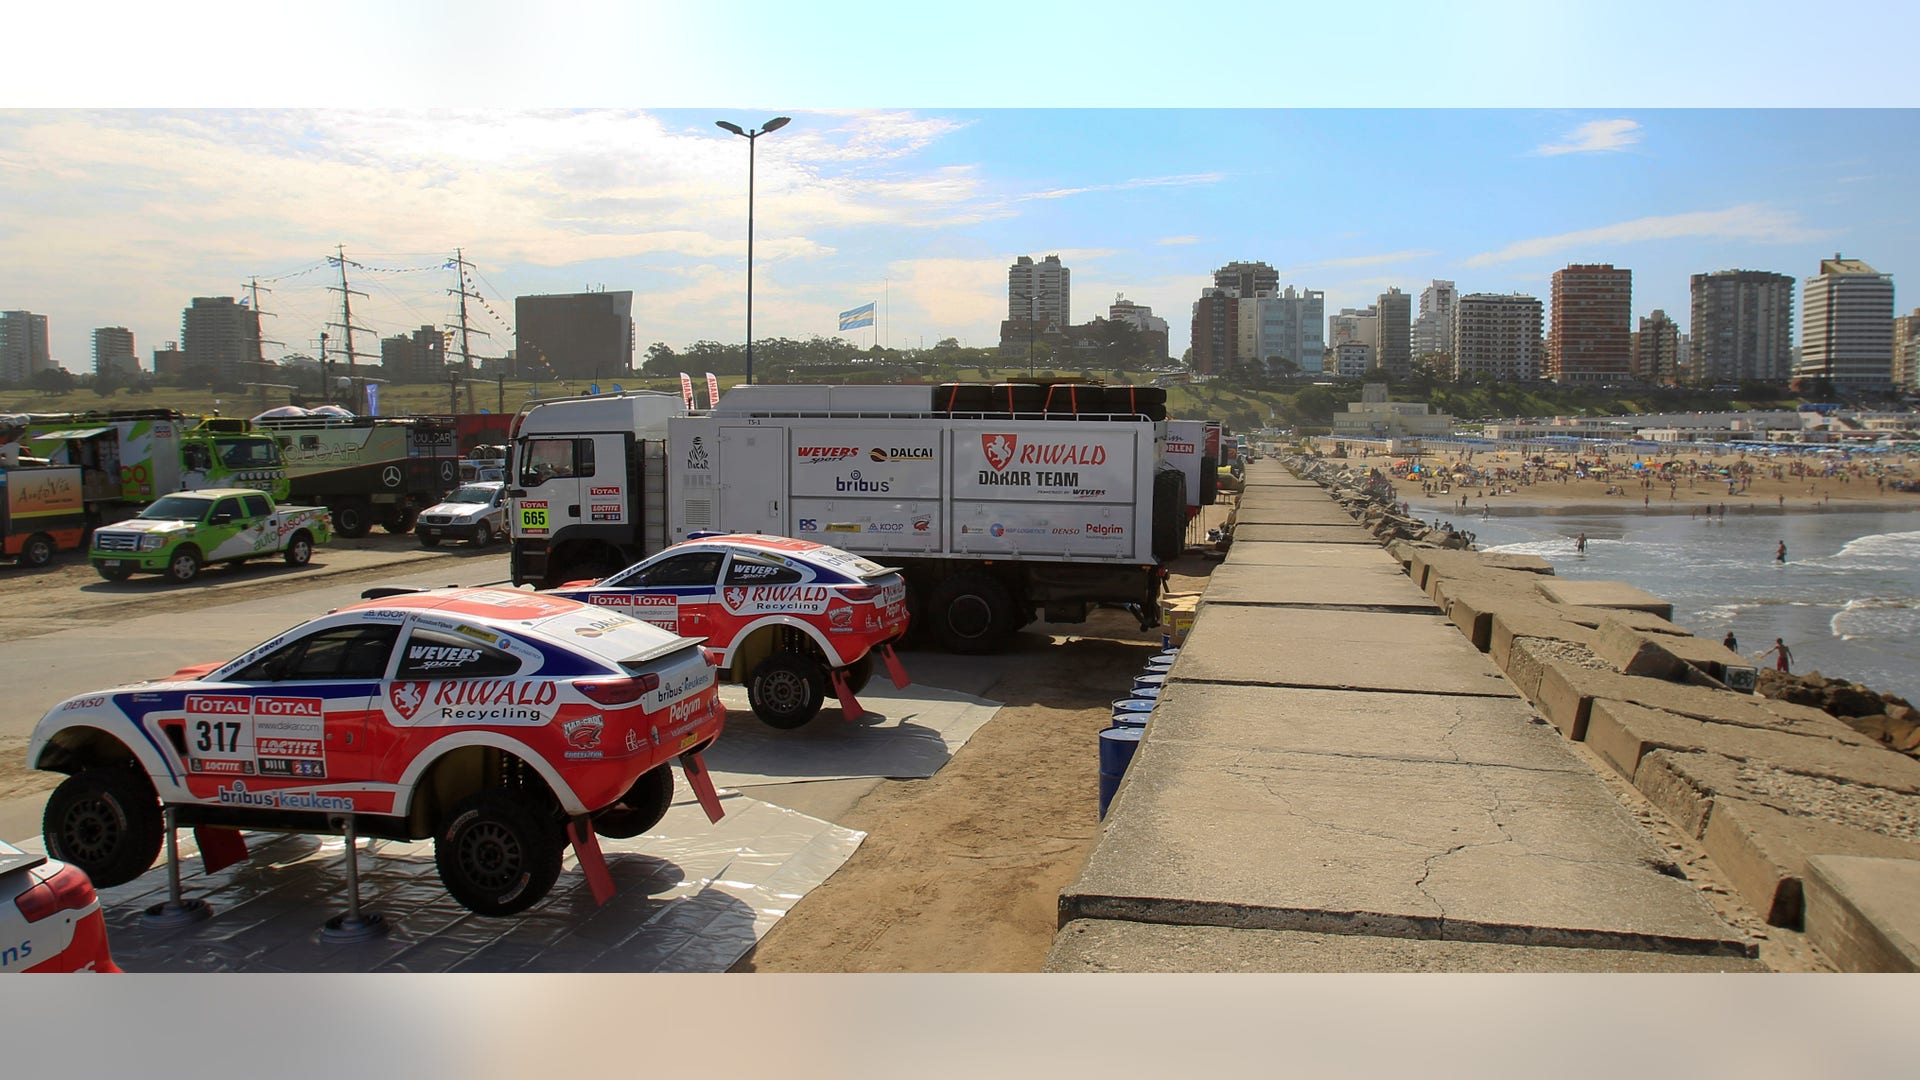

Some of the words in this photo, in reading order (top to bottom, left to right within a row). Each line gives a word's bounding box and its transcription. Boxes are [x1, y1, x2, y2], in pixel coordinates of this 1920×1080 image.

[284, 442, 360, 462] OLCAR
[798, 447, 860, 457] WEVERS
[890, 448, 933, 458] DALCAI
[1020, 444, 1107, 466] RIWALD
[1167, 444, 1193, 452] RLEN
[687, 459, 710, 470] DAKAR
[806, 454, 848, 465] sport
[836, 470, 890, 493] bribus
[978, 470, 1031, 486] DAKAR
[1036, 471, 1079, 487] TEAM
[592, 487, 619, 495] TOTAL
[523, 511, 546, 526] 665
[1086, 523, 1124, 536] Pelgrim
[734, 564, 780, 575] WEVERS
[592, 595, 630, 605] TOTAL
[635, 595, 676, 606] TOTAL
[752, 586, 828, 602] RIWALD
[756, 602, 819, 611] Recycling
[409, 645, 483, 662] WEVERS
[423, 657, 467, 670] sport
[434, 680, 557, 706] RIWALD
[658, 682, 683, 703] bribus
[62, 697, 105, 712] DENSO
[190, 697, 249, 713] TOTAL
[258, 698, 320, 715] TOTAL
[669, 697, 701, 724] Pelgrim
[441, 706, 542, 721] Recycling
[257, 721, 320, 733] www.dakar.com
[196, 720, 242, 753] 317
[260, 740, 318, 755] LOCTITE
[205, 761, 240, 771] LOCTITE
[220, 780, 274, 806] bribus
[278, 792, 353, 811] keukens
